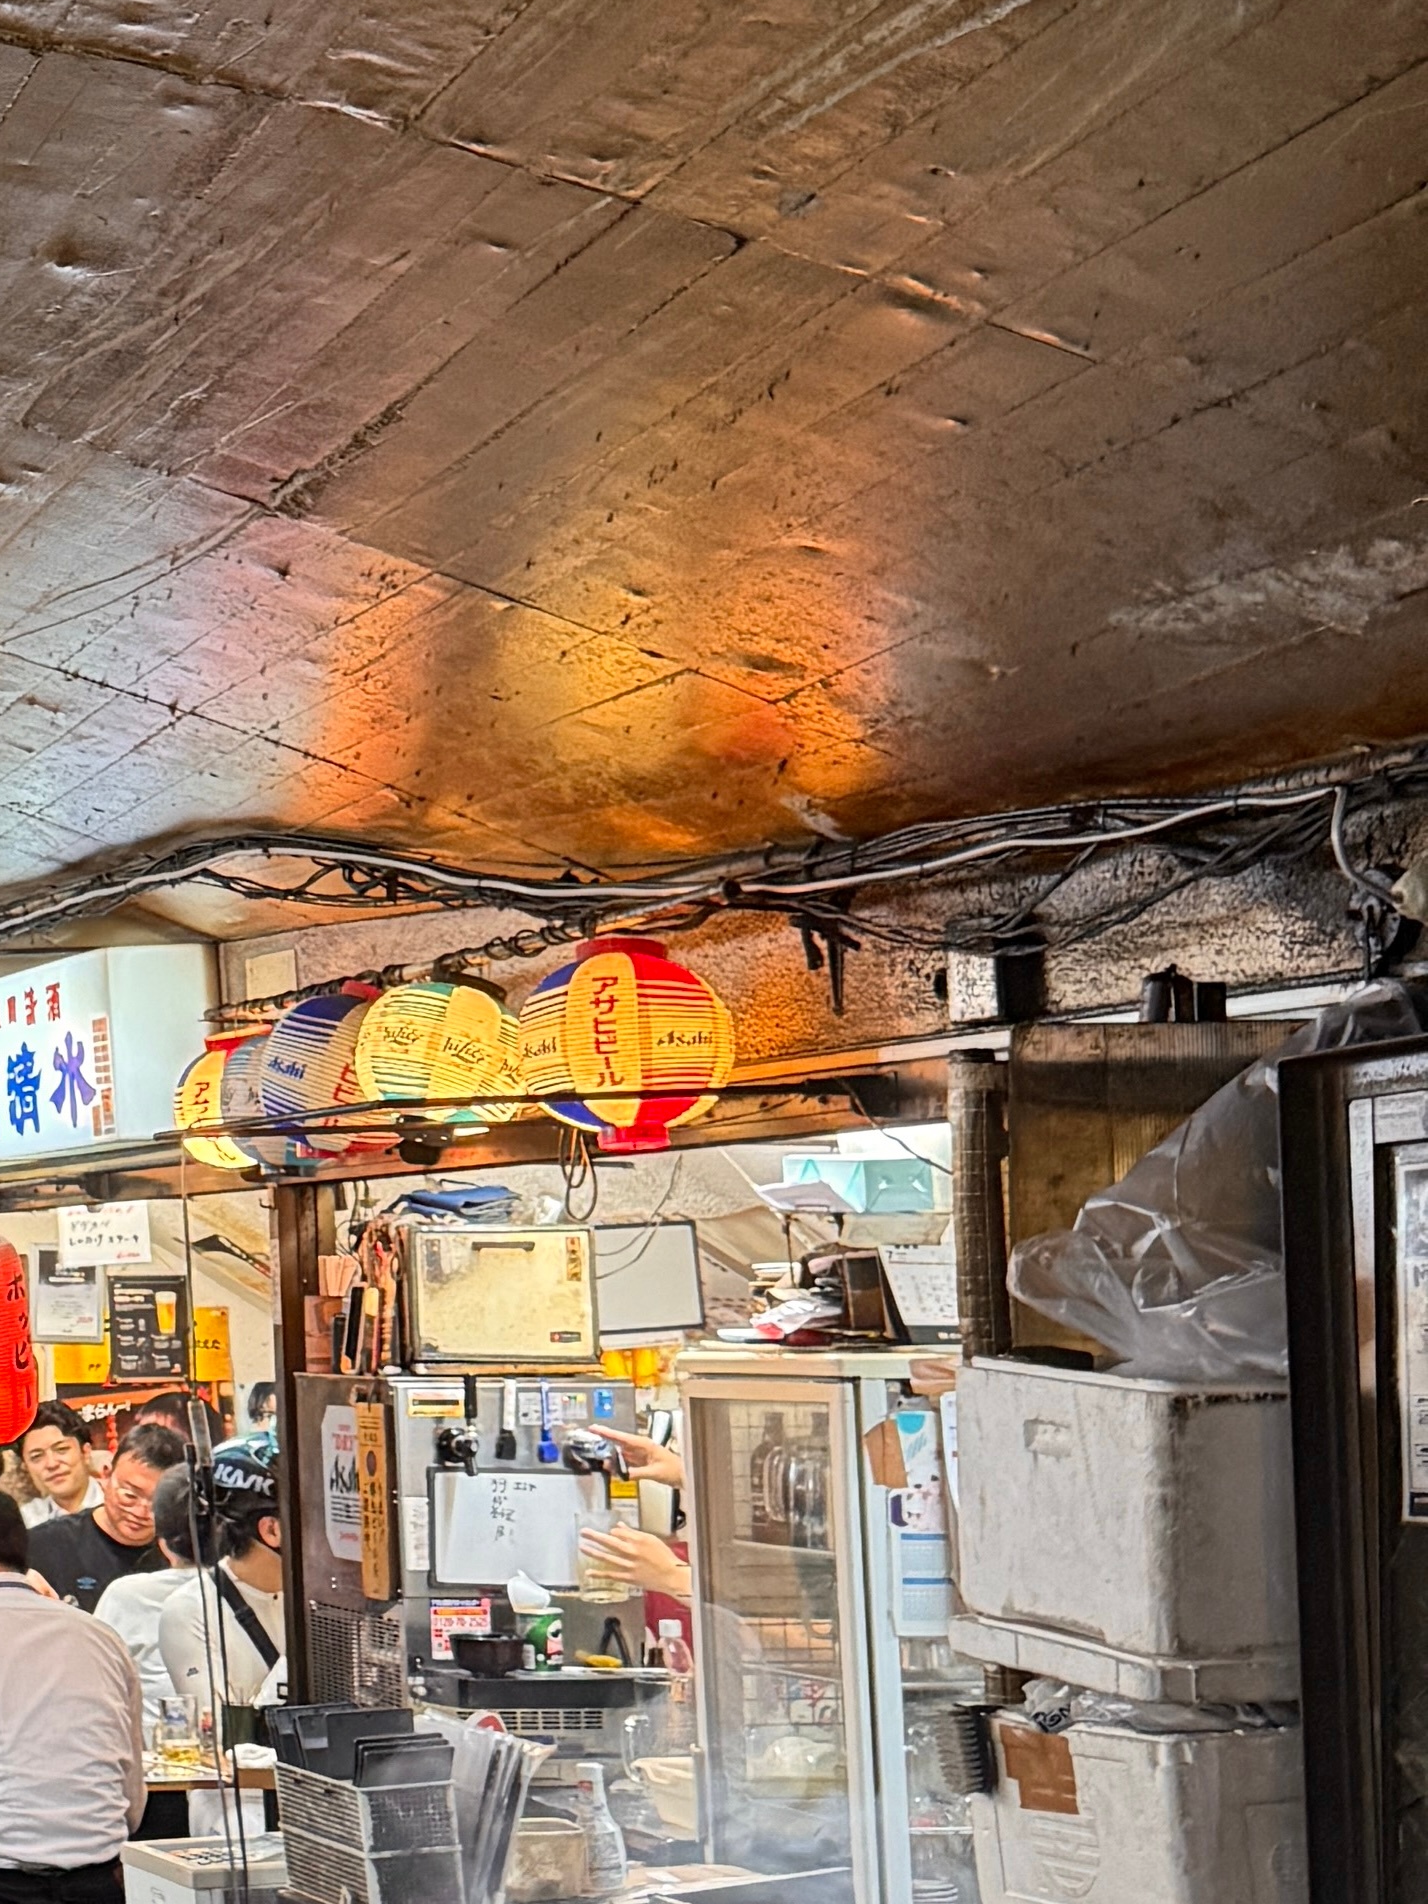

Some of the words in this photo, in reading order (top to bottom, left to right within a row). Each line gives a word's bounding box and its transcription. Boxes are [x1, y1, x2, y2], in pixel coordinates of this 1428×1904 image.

[589, 977, 624, 1086] アサヒビール
[657, 1031, 713, 1048] Asahi
[523, 1036, 557, 1059] sahi
[268, 1056, 306, 1080] Asahi
[214, 1463, 275, 1496] KASK
